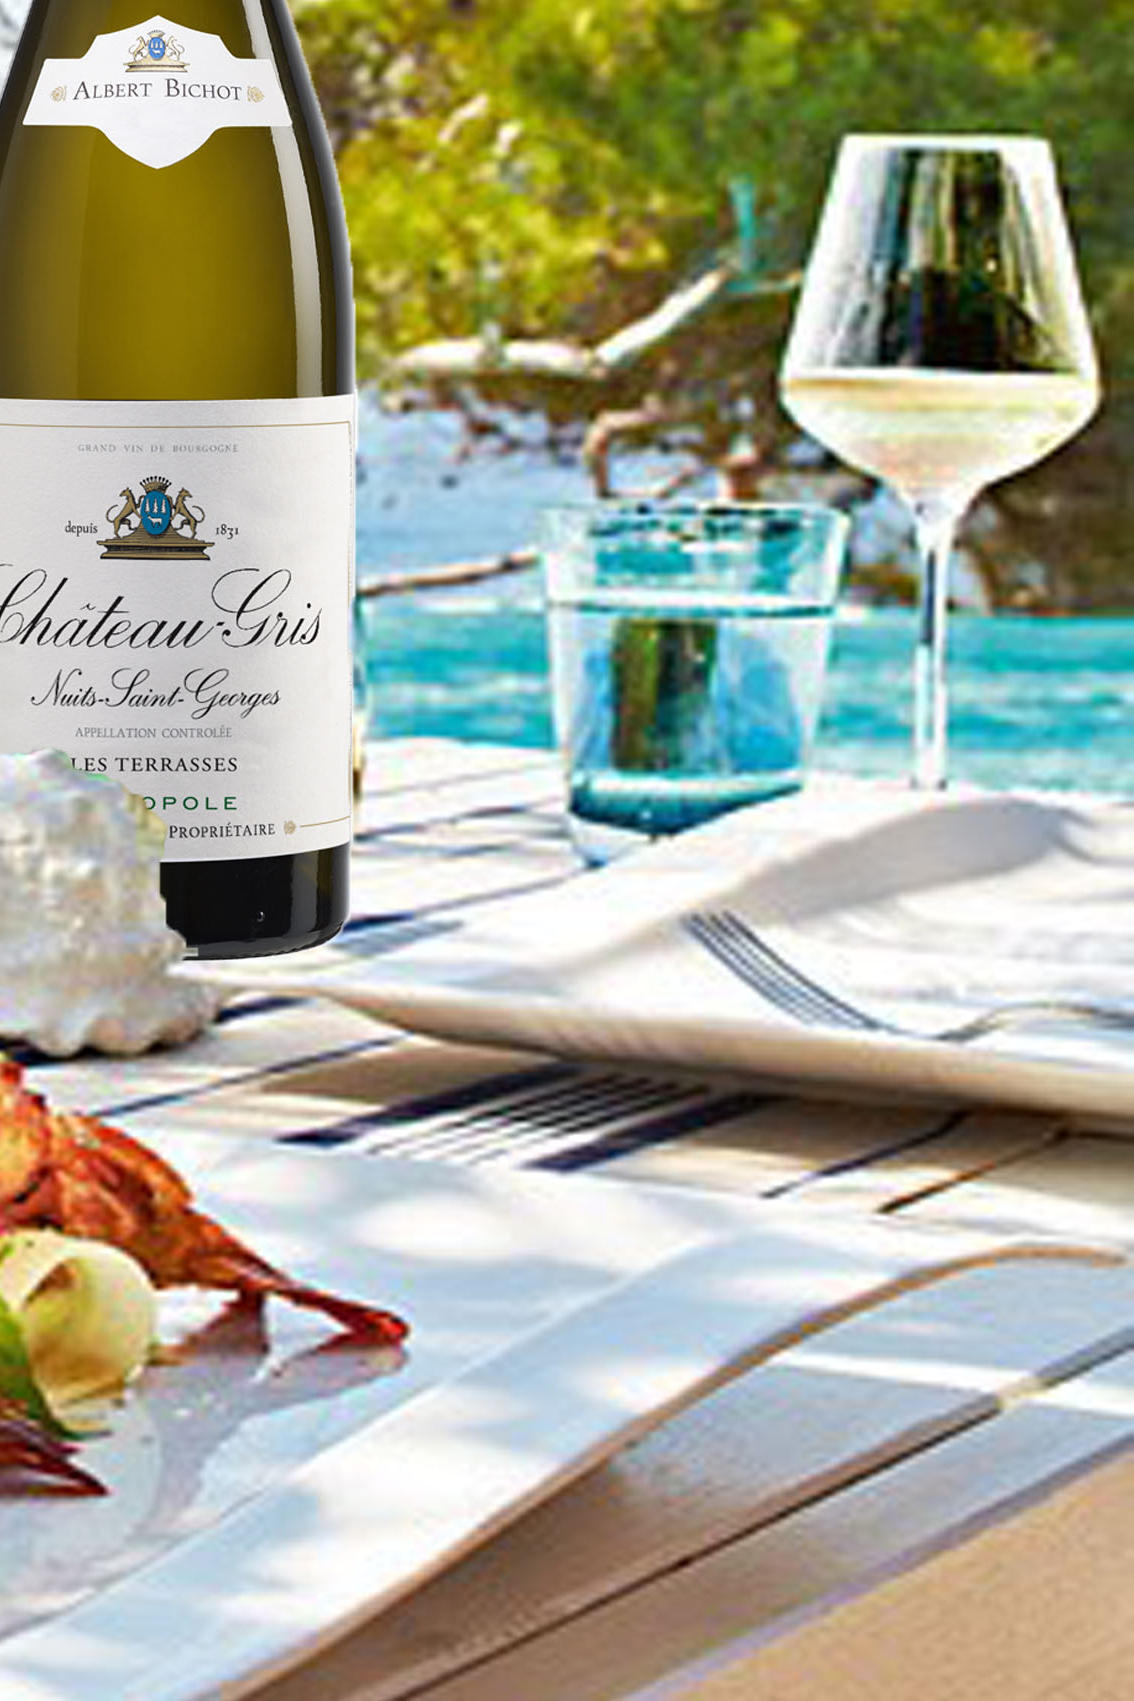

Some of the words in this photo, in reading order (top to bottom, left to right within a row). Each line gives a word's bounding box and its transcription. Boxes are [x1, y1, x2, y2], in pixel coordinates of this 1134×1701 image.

[72, 81, 153, 101] ALBERT
[164, 78, 243, 101] BICHOT
[77, 444, 117, 453] GRAND
[123, 444, 144, 453] VIN
[150, 444, 165, 453] DE
[172, 444, 239, 453] BOURGOGNE
[64, 520, 99, 537] depuis
[215, 523, 240, 540] 1831
[30, 667, 282, 721] Nuits-Saint-Georges
[74, 726, 157, 739] APPELLATION
[70, 757, 108, 772] LES
[114, 757, 238, 772] TERRASSES
[142, 796, 238, 811] OPOLE
[168, 822, 276, 840] PROPRIÉTAIRE
